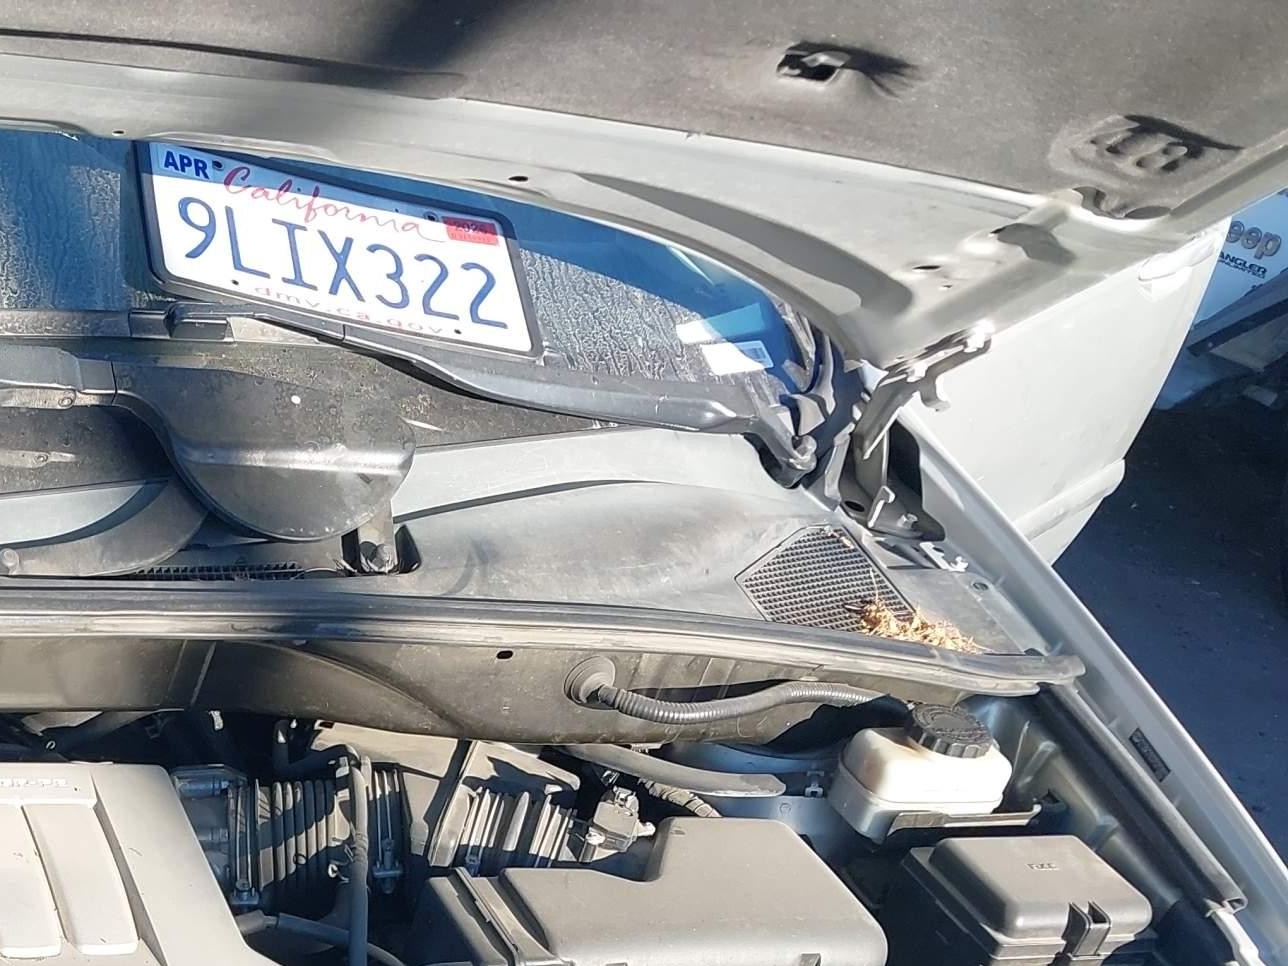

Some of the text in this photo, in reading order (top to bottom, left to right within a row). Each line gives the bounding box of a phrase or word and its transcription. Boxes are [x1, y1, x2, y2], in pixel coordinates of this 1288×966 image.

[164, 150, 210, 179] APR
[223, 166, 446, 242] California
[177, 196, 508, 329] 9LIX322
[1225, 220, 1282, 260] eep
